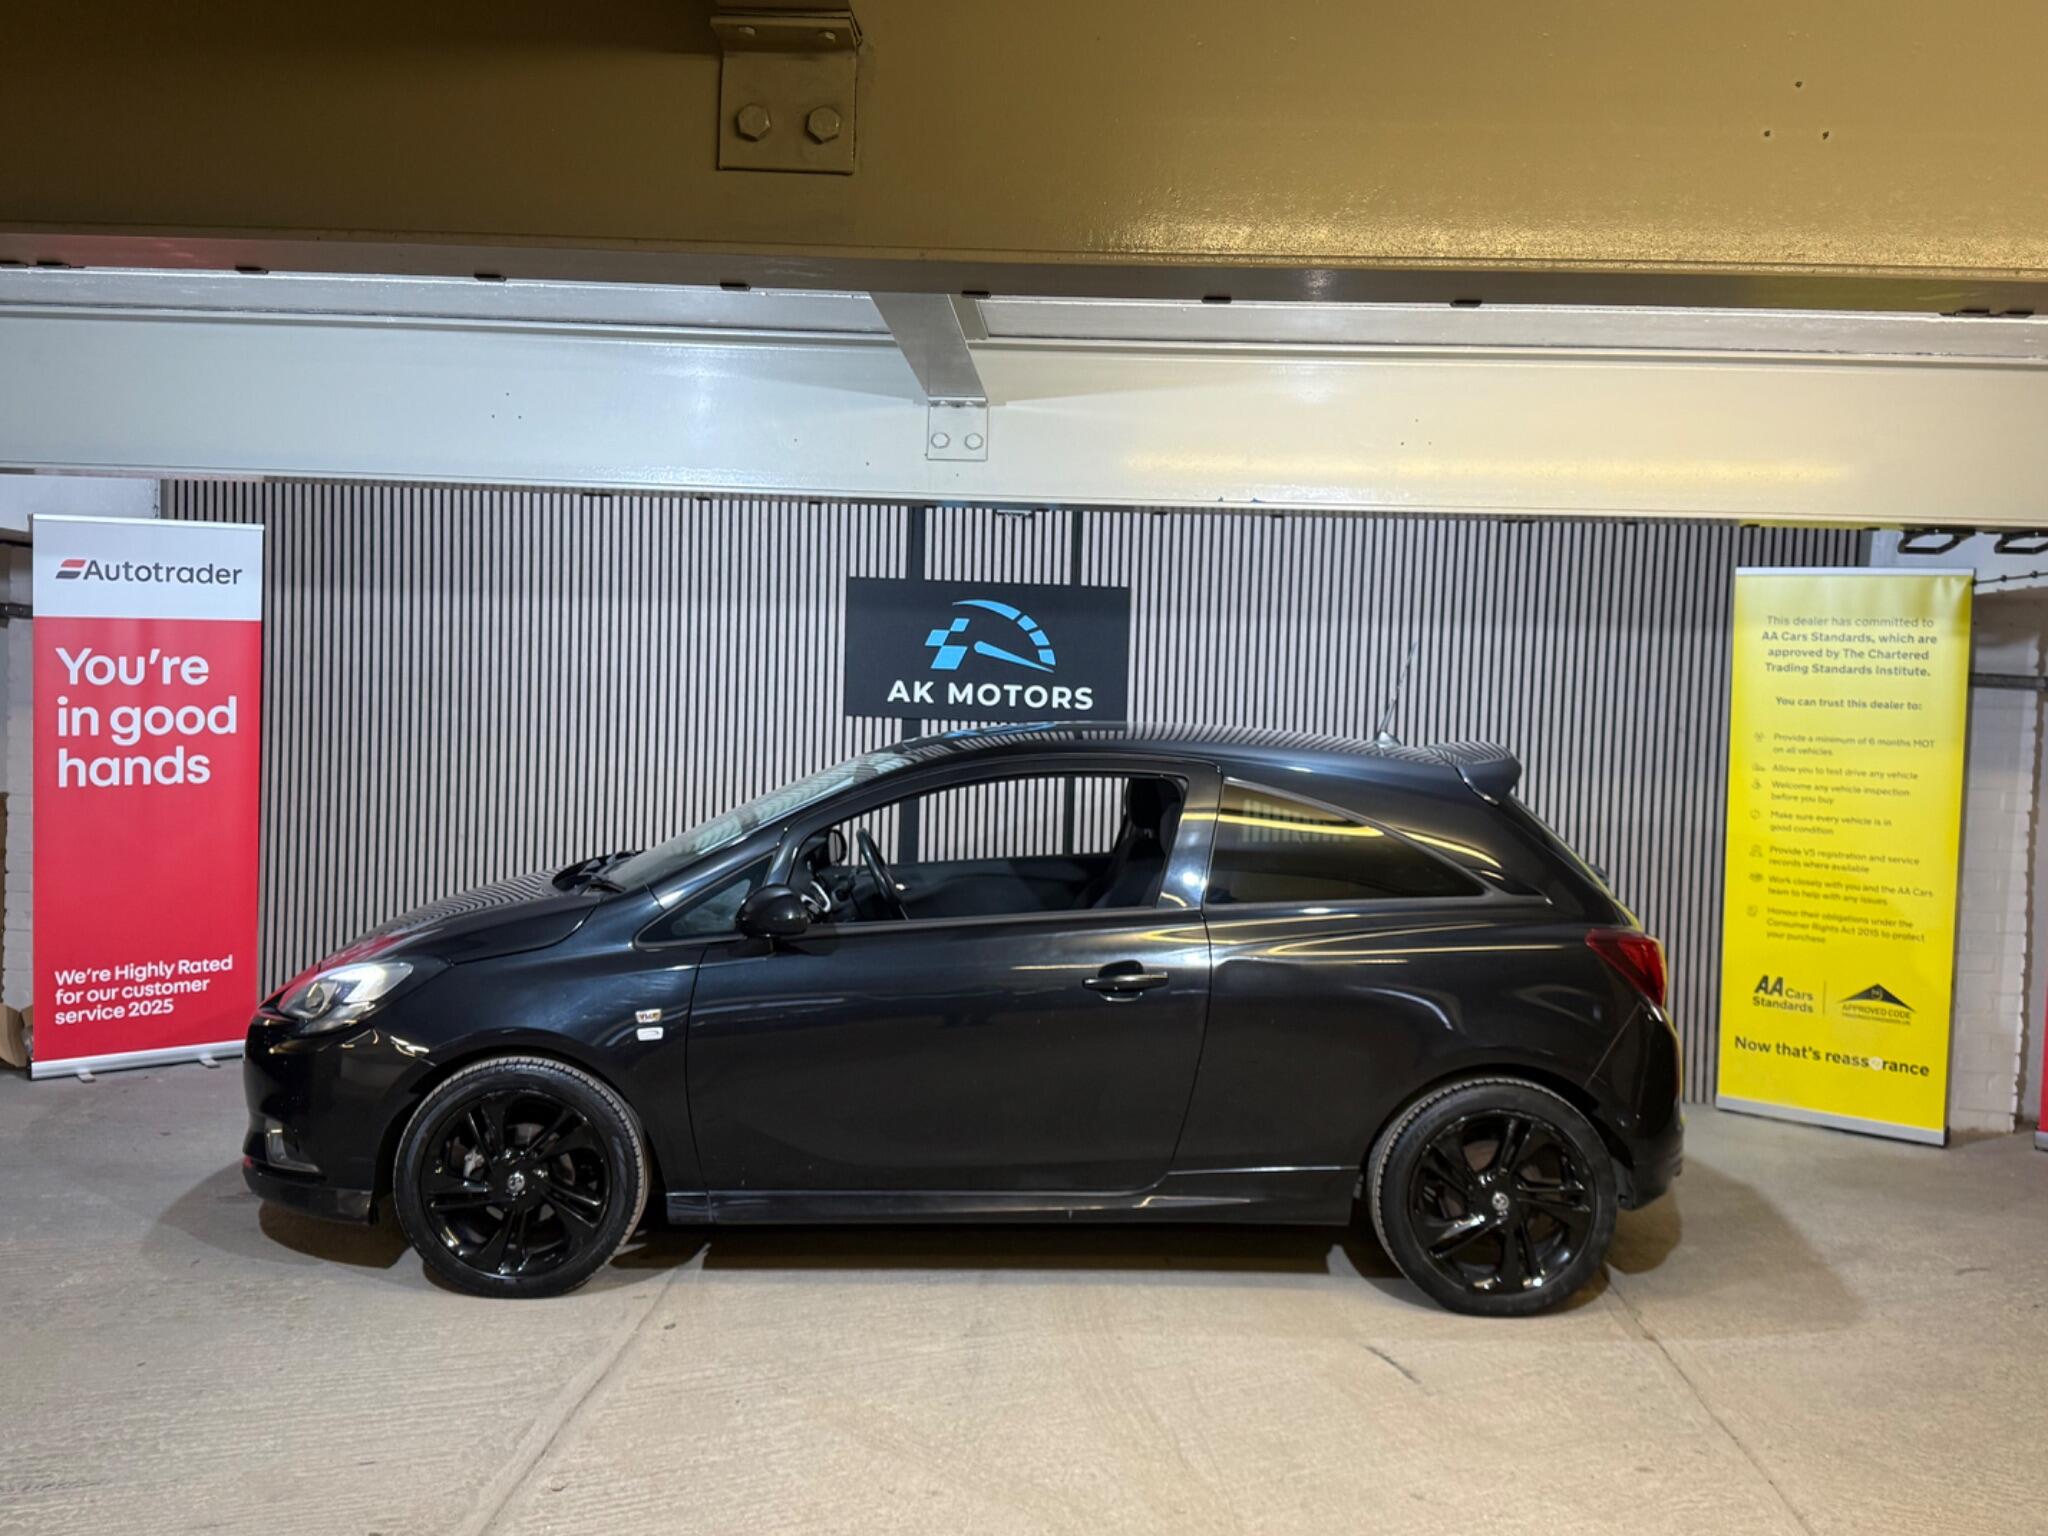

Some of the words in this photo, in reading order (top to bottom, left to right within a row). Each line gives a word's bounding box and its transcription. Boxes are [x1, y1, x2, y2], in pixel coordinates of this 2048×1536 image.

[83, 560, 242, 585] Autotrader
[1767, 616, 1789, 626] This
[1793, 616, 1828, 626] dealer
[1832, 617, 1850, 626] has
[1855, 618, 1918, 627] committed
[1922, 619, 1934, 627] to
[1762, 631, 1778, 640] AA
[1781, 632, 1808, 641] Cars
[1811, 632, 1876, 643] Standards,
[1878, 634, 1914, 644] which
[1768, 649, 1823, 658] approved
[1826, 649, 1840, 659] by
[1842, 649, 1864, 658] The
[1868, 650, 1929, 660] Chartered
[1765, 663, 1808, 674] Trading
[1812, 664, 1872, 674] Standards
[1876, 666, 1931, 676] Institute.
[887, 680, 934, 704] AK
[948, 682, 1094, 710] MOTORS
[1776, 697, 1795, 706] You
[1819, 699, 1844, 707] trust
[1847, 700, 1867, 708] this
[1870, 701, 1904, 710] dealer
[1907, 702, 1922, 710] to:
[57, 696, 99, 736] in
[110, 696, 237, 746] good
[1774, 733, 1806, 742] Provide
[1913, 739, 1935, 748] MOT
[58, 746, 210, 788] hands
[1898, 886, 1910, 895] AA
[1913, 888, 1933, 897] Cars
[115, 961, 175, 982] Highly
[178, 955, 232, 975] Rated
[55, 989, 83, 1005] for
[87, 988, 119, 1002] our
[122, 979, 210, 998] customer
[1754, 975, 1783, 996] AA
[1785, 988, 1813, 1000] Cars
[55, 1005, 125, 1025] service
[128, 998, 173, 1017] 2025
[1753, 996, 1813, 1013] Standards
[1735, 1036, 1771, 1053] Now
[1825, 1051, 1930, 1077] reassrance
